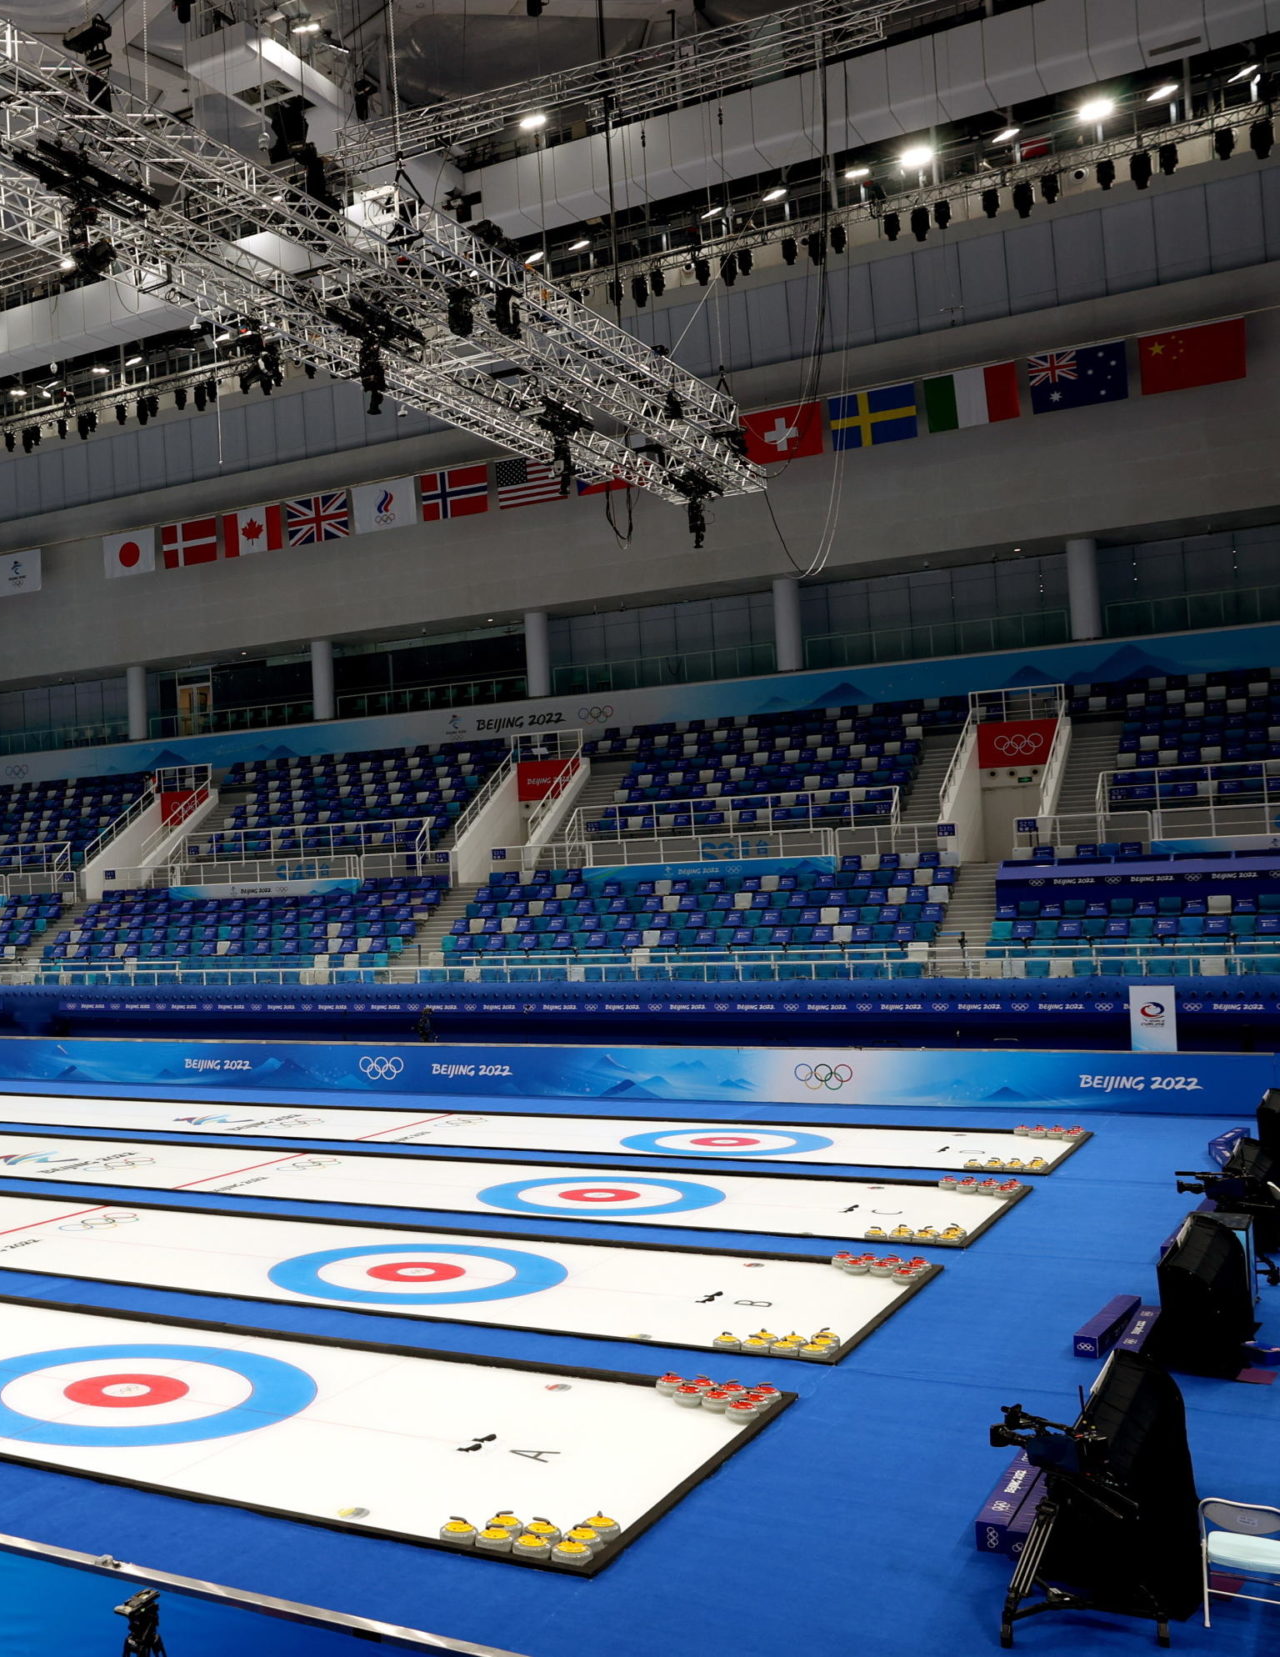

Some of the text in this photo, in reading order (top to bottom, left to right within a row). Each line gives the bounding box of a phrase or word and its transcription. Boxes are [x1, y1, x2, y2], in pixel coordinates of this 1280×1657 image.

[476, 715, 526, 733] BEIJING
[528, 712, 567, 727] 2022
[1130, 875, 1155, 883] BEIJING
[1211, 872, 1237, 880] BEIJING
[1053, 878, 1077, 886] BEIJING
[1213, 1003, 1265, 1011] BEIJING 2022
[185, 1059, 252, 1072] BEIJING 2022
[432, 1064, 513, 1079] BEIJING 2022
[1079, 1074, 1203, 1093] BEIJING 2022
[733, 1299, 773, 1308] B
[509, 1449, 562, 1463] A
